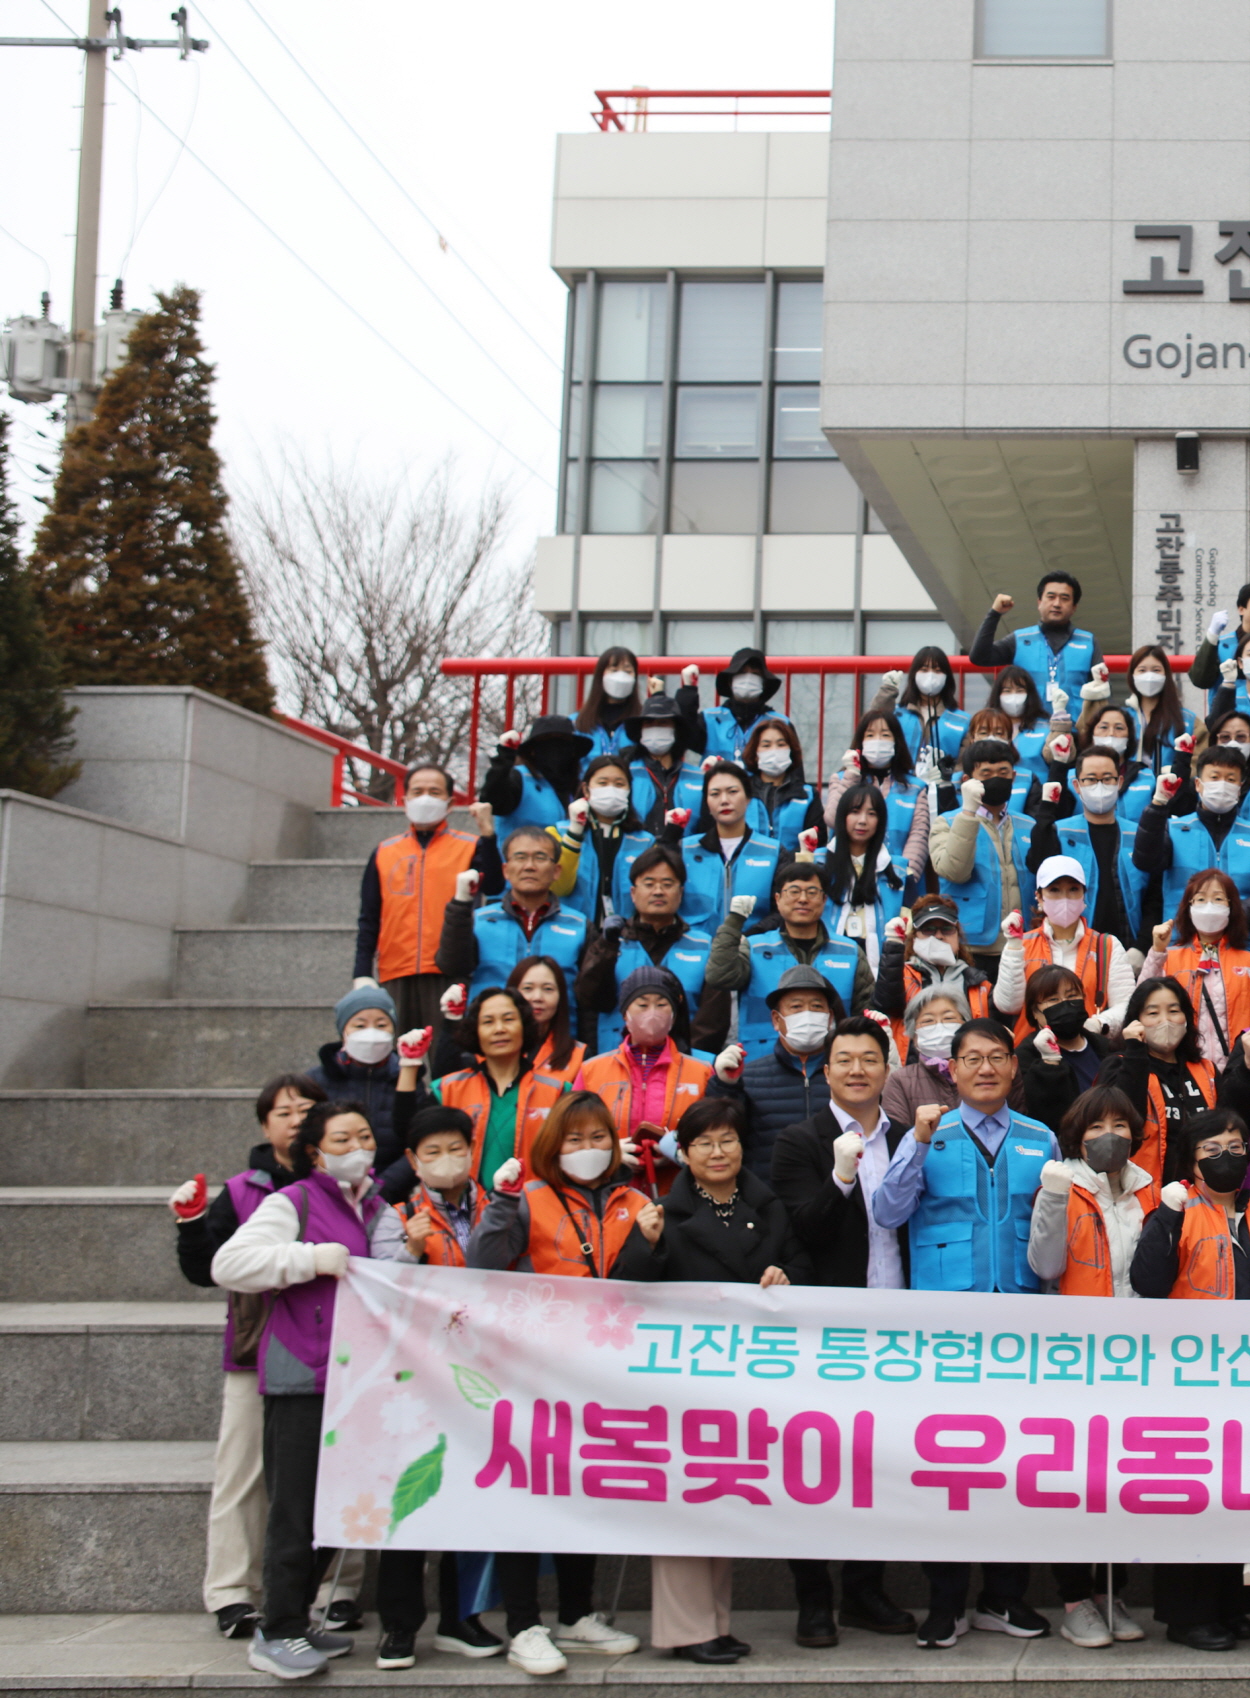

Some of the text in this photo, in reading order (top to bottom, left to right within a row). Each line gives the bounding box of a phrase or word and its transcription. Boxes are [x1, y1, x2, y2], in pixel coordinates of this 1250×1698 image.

[1155, 513, 1185, 694] 고잔동주민자
[1194, 547, 1205, 606] Community
[1206, 547, 1219, 608] Gojan-dong
[627, 1323, 800, 1380] 고잔동
[815, 1328, 1157, 1388] 통장협의회와
[475, 1398, 875, 1509] 새봄맞이
